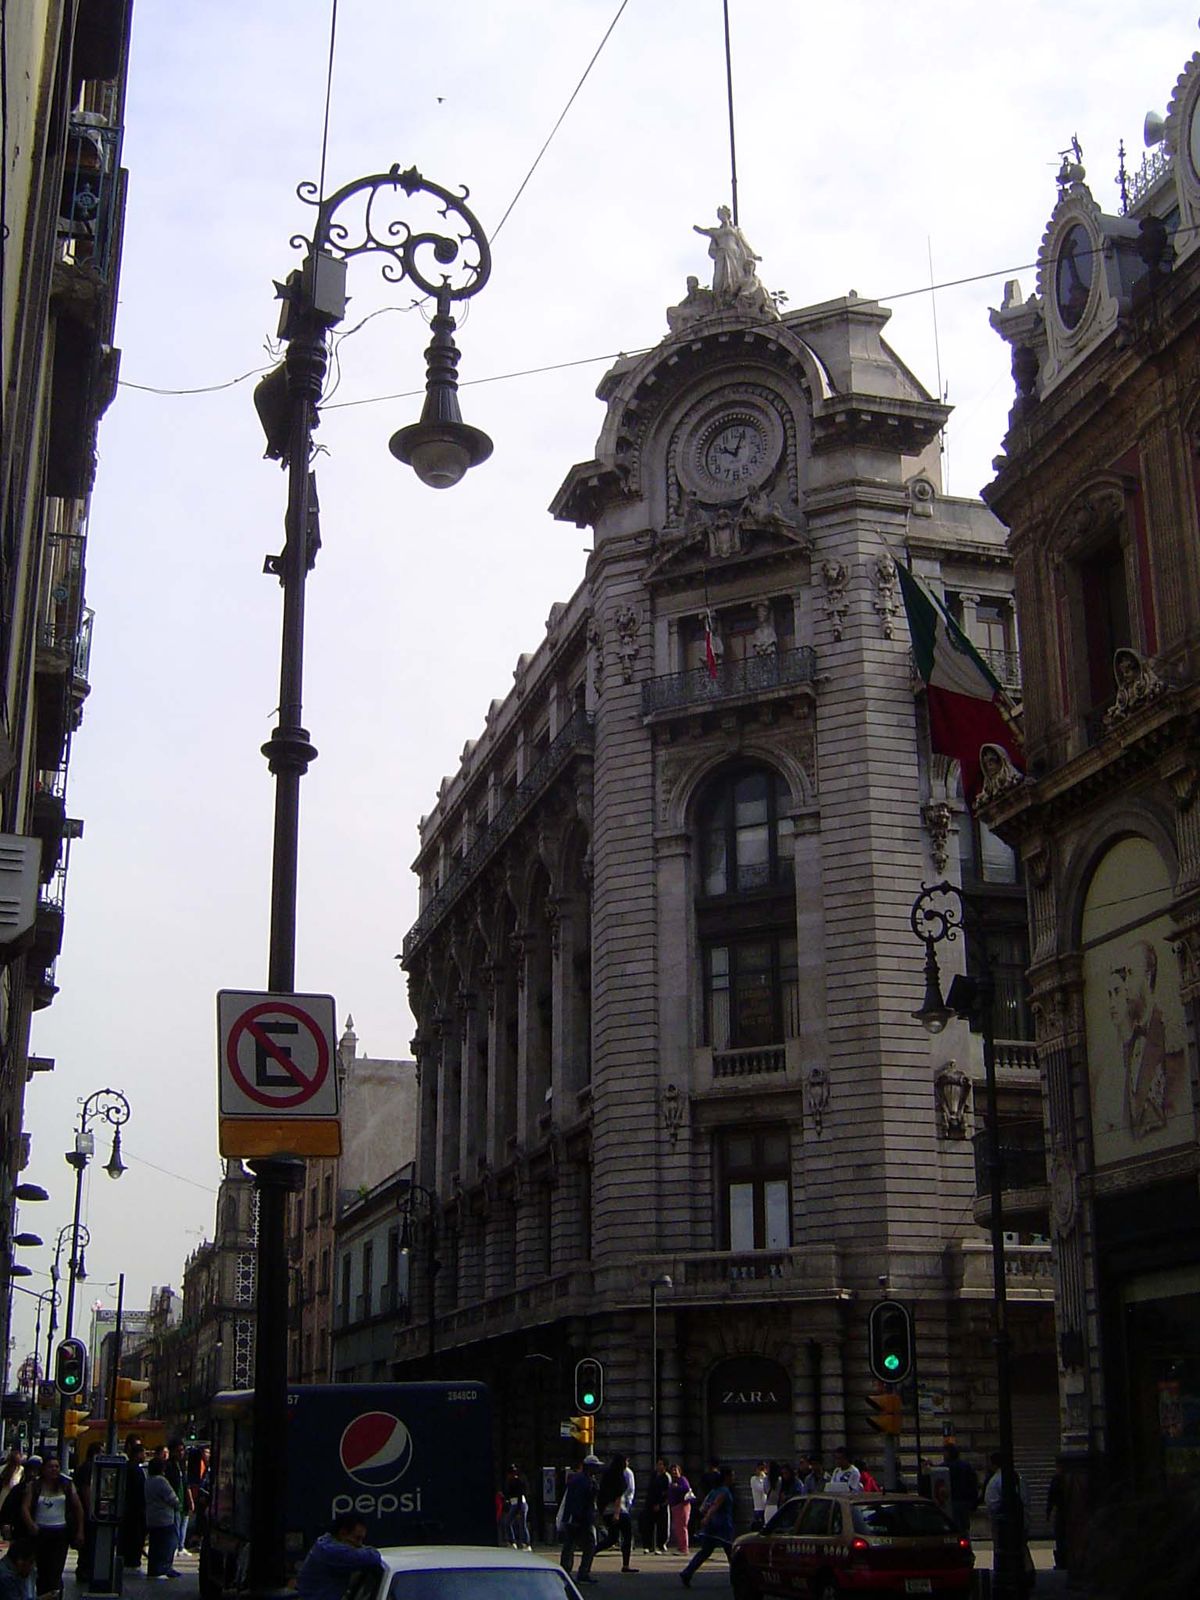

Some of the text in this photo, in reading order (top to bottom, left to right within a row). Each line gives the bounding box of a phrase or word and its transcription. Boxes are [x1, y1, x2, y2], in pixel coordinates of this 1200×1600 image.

[253, 1021, 302, 1087] E
[721, 1391, 778, 1404] ZARA
[331, 1487, 422, 1520] pepsi
